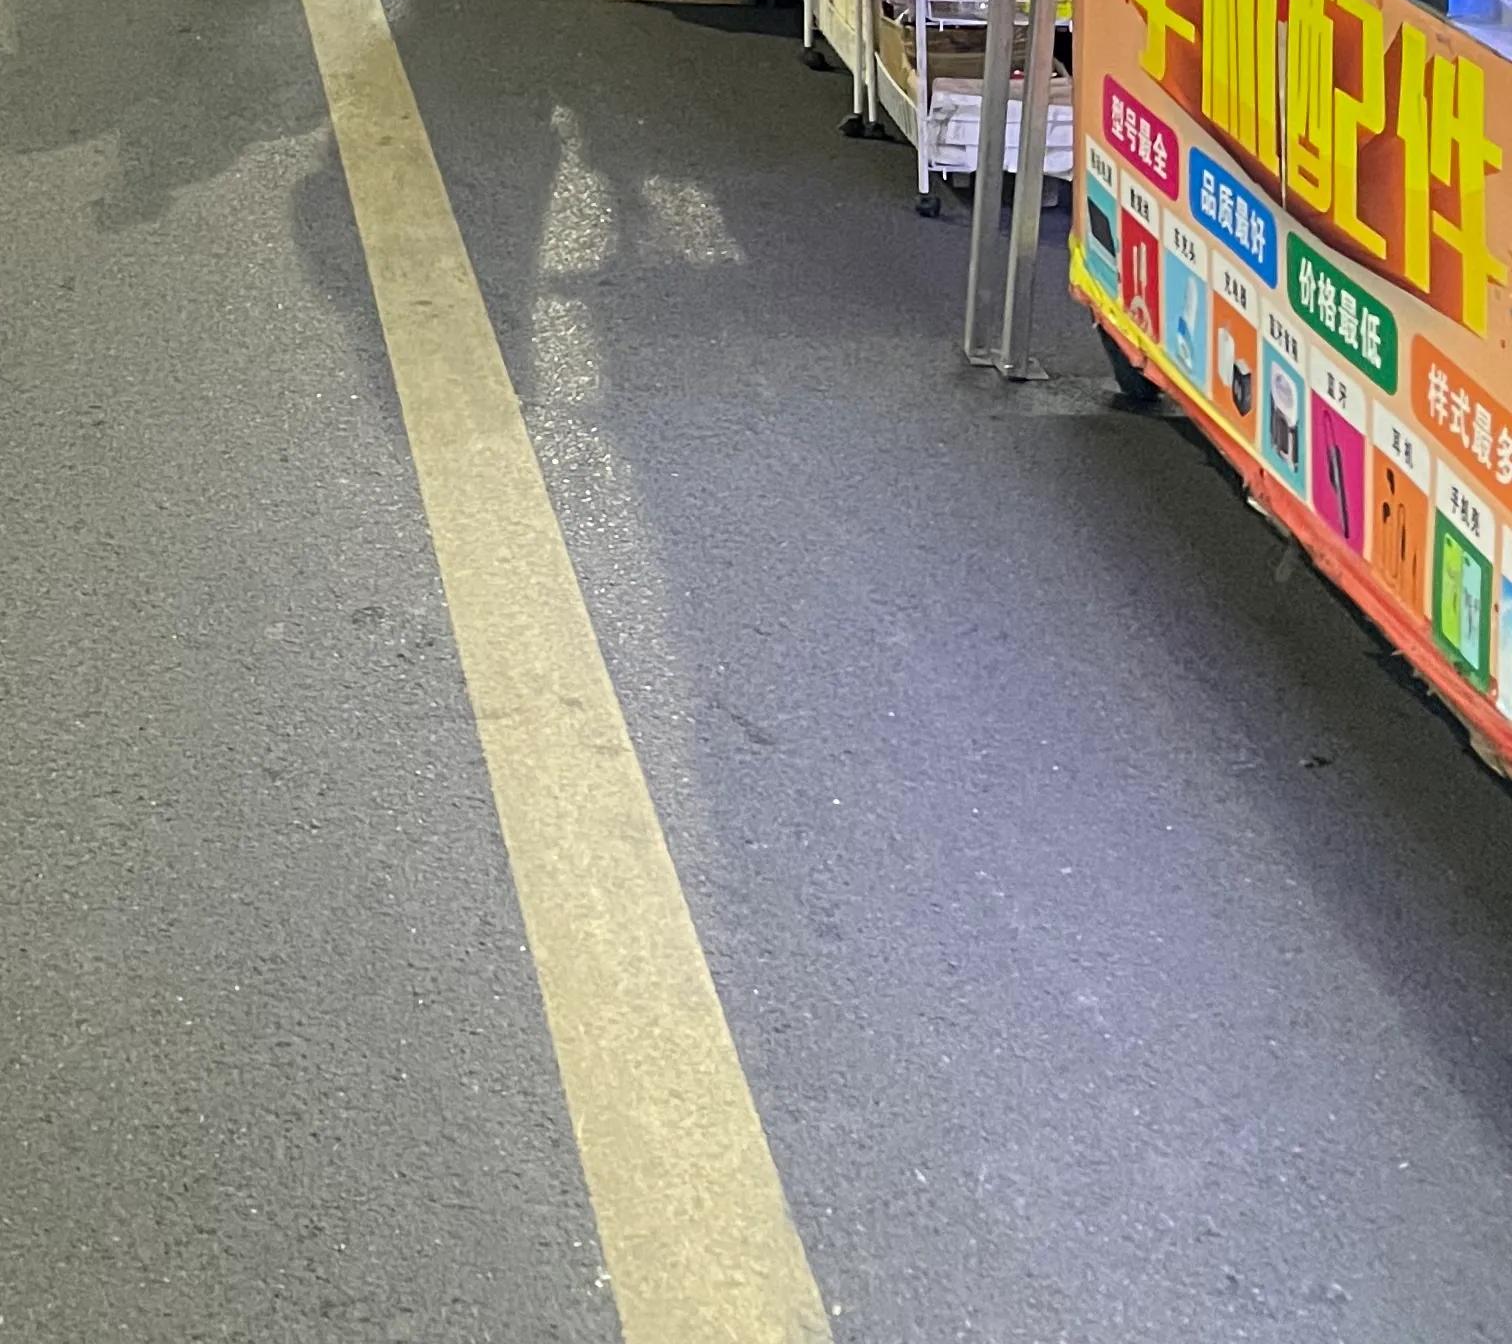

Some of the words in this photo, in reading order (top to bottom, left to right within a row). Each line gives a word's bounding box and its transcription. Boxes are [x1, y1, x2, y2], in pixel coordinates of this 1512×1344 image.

[1110, 94, 1168, 181] 型号最全
[1201, 168, 1266, 264] 品质最好
[1299, 256, 1382, 369] 价格最低
[1427, 362, 1512, 486] 样式最多
